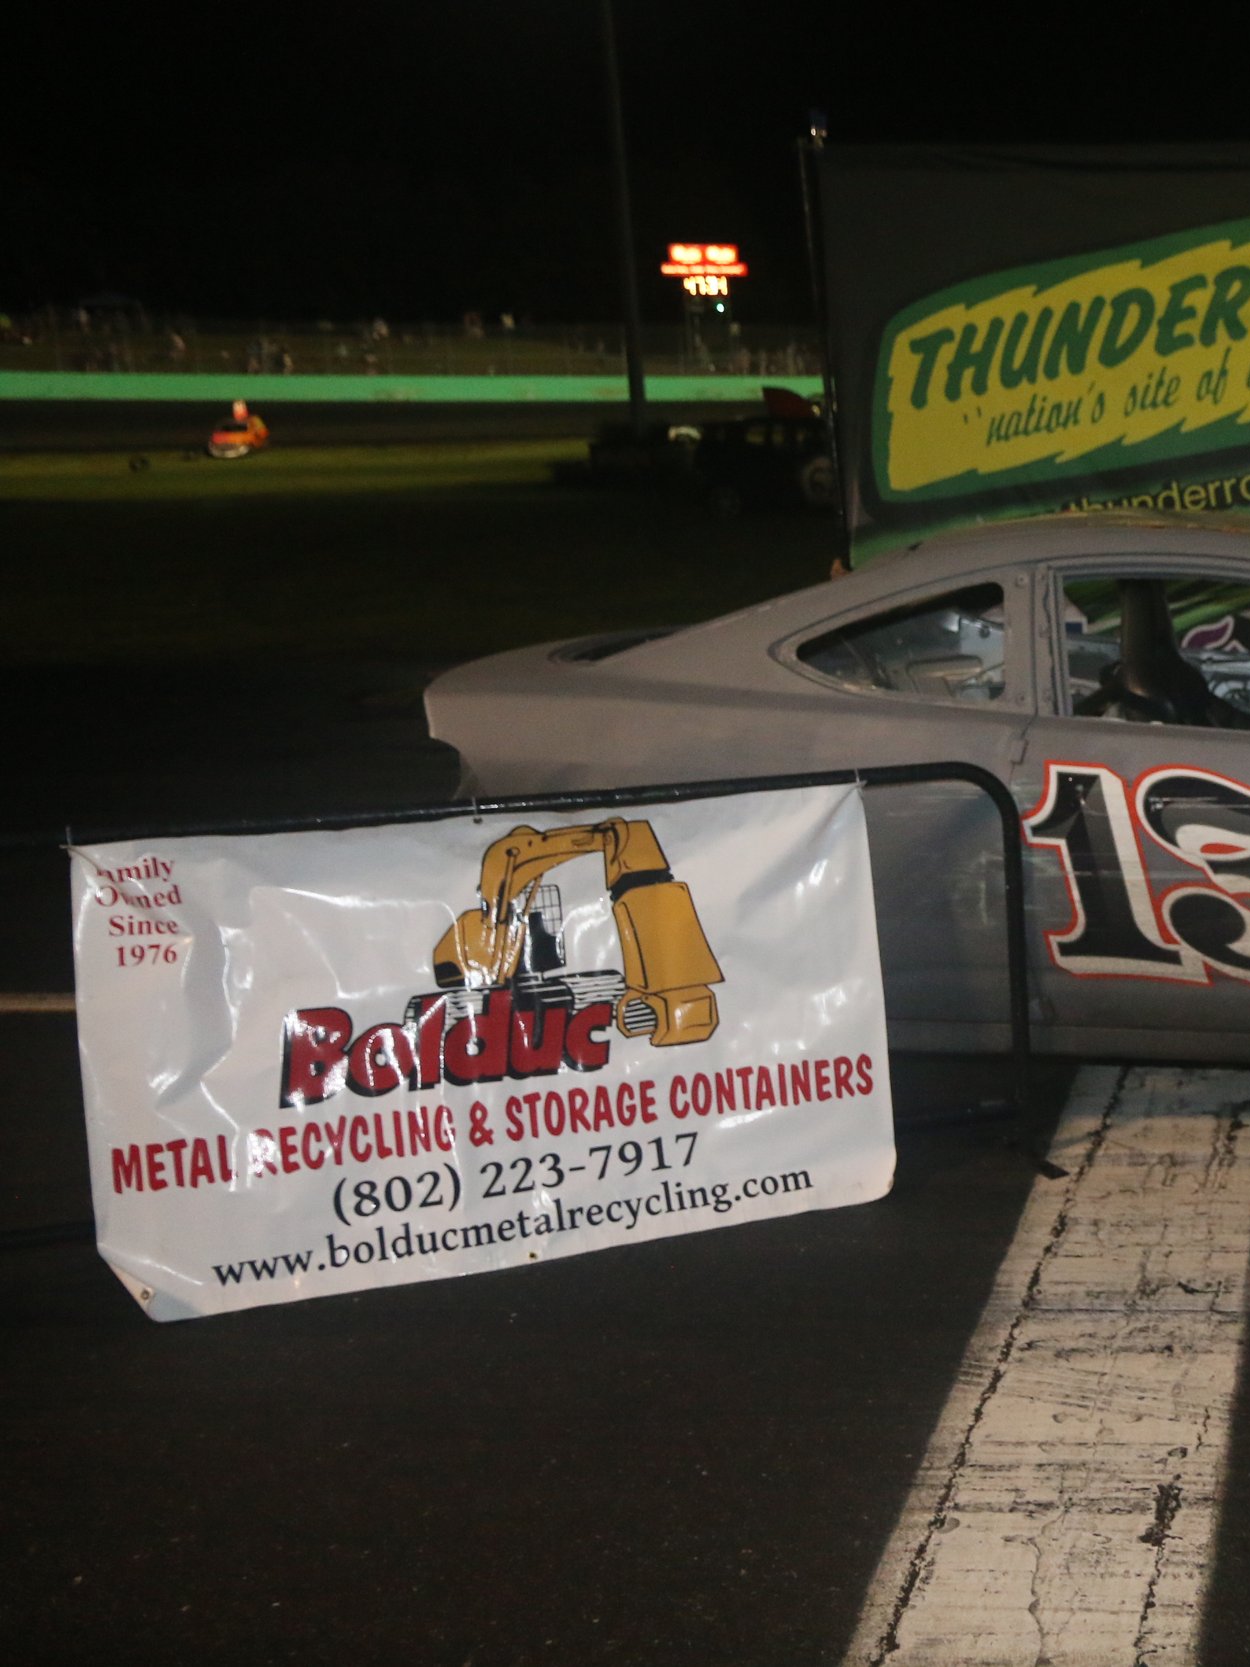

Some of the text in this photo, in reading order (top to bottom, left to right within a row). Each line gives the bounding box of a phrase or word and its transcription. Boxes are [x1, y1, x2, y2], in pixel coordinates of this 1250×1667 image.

[1124, 366, 1181, 420] site
[1196, 348, 1231, 405] of
[96, 856, 175, 882] amily
[108, 915, 179, 937] Since
[116, 944, 178, 967] 1976
[280, 990, 613, 1108] Bolduc
[112, 1054, 873, 1194] METAL RECYCLING & STORAGE CONTAINERS
[334, 1132, 698, 1226] (802) 223-7917
[212, 1170, 813, 1287] www.bolducmetalrecycling.com
